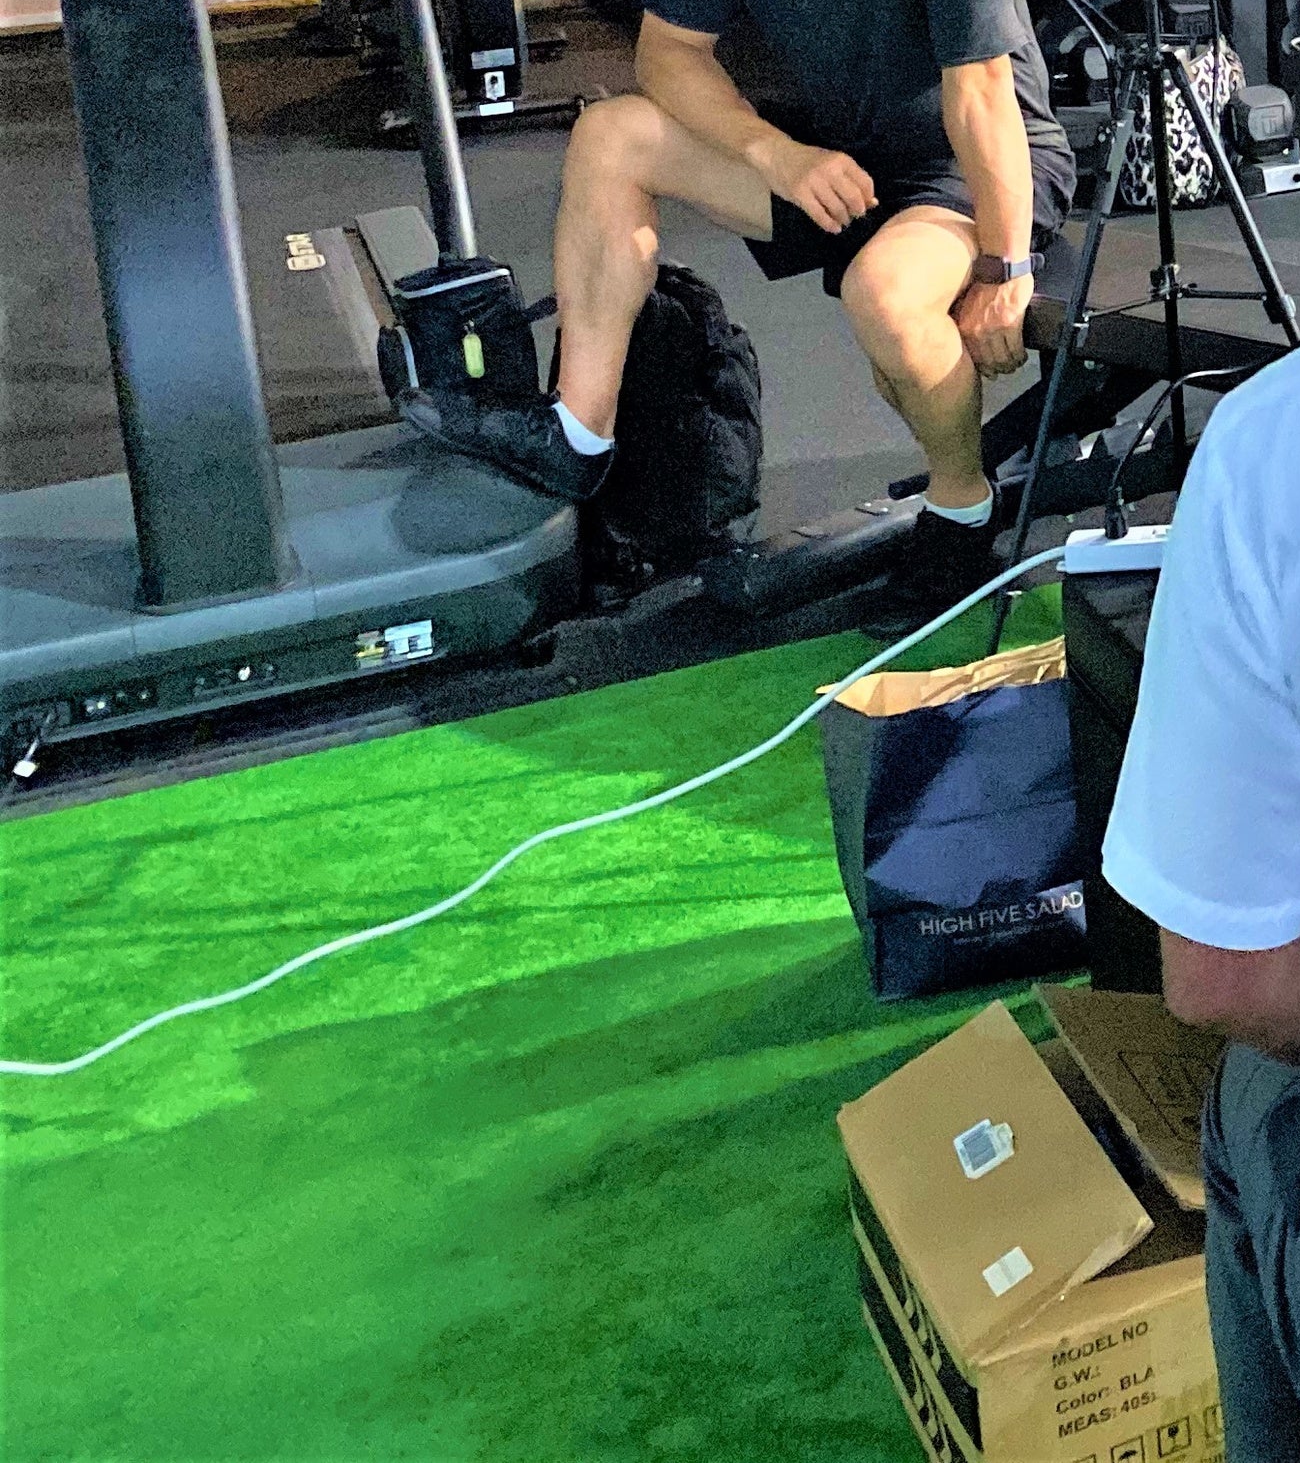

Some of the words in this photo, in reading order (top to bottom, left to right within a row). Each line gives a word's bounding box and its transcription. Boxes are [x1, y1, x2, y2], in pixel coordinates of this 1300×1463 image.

[920, 916, 973, 936] HIGH
[978, 904, 1021, 929] FIVE
[1025, 891, 1084, 920] SALAD
[1051, 1335, 1119, 1369] MODEL
